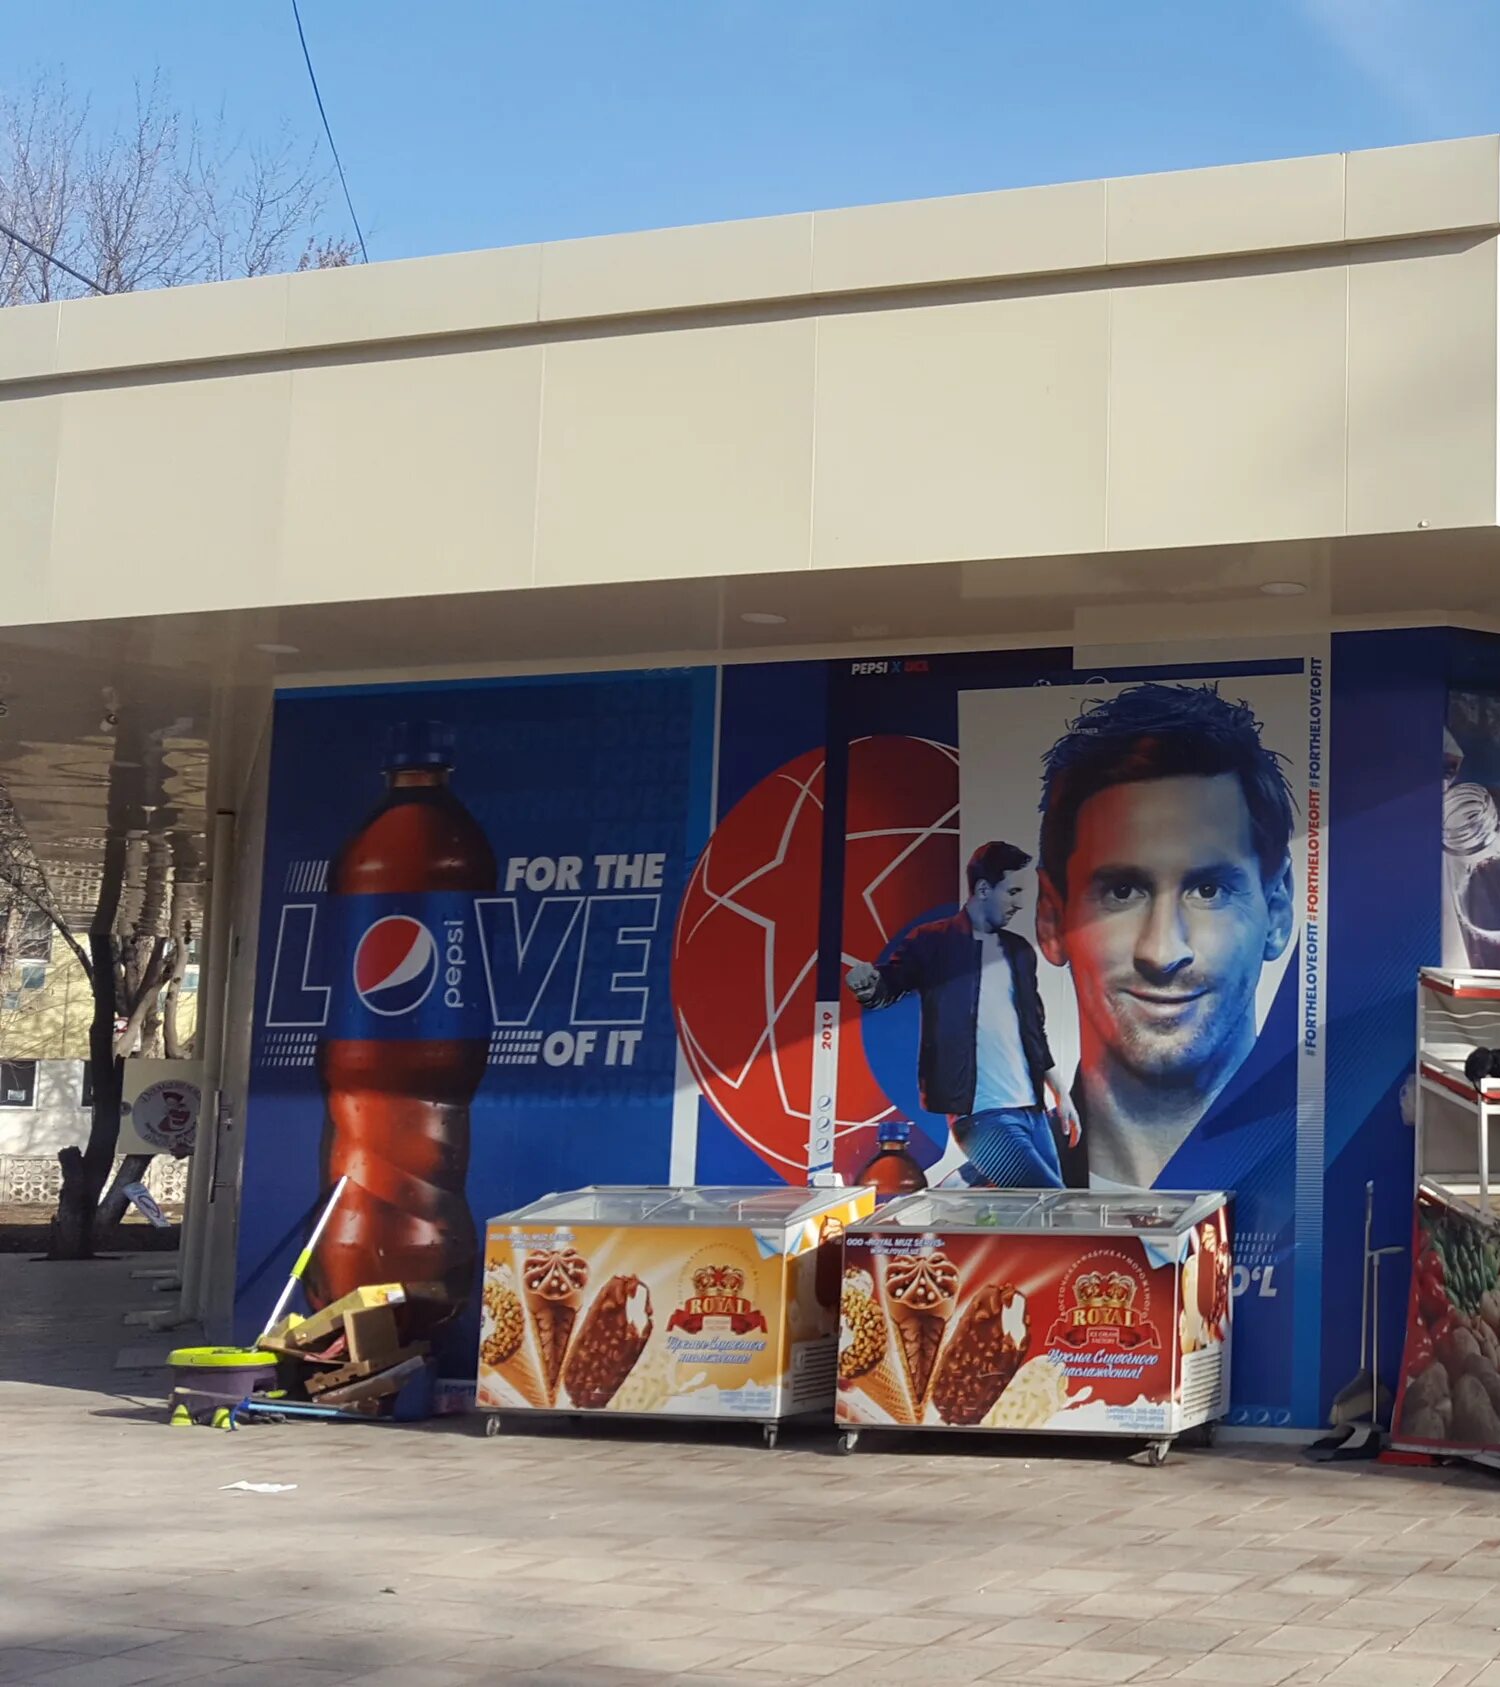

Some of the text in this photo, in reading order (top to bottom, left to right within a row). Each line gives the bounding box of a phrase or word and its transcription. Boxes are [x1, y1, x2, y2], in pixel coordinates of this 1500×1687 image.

[851, 661, 888, 675] PEPSI
[505, 853, 666, 891] FOR THE
[1305, 657, 1322, 1056] #FORTHELOVEOFIT #FORTHELOVEOFIT #FORTHELOVEOFIT
[444, 920, 466, 1008] pepsi
[543, 1030, 642, 1066] OF IT
[821, 1011, 833, 1050] 2019
[690, 1299, 746, 1315] ROYAL
[1072, 1307, 1135, 1328] ROYAL
